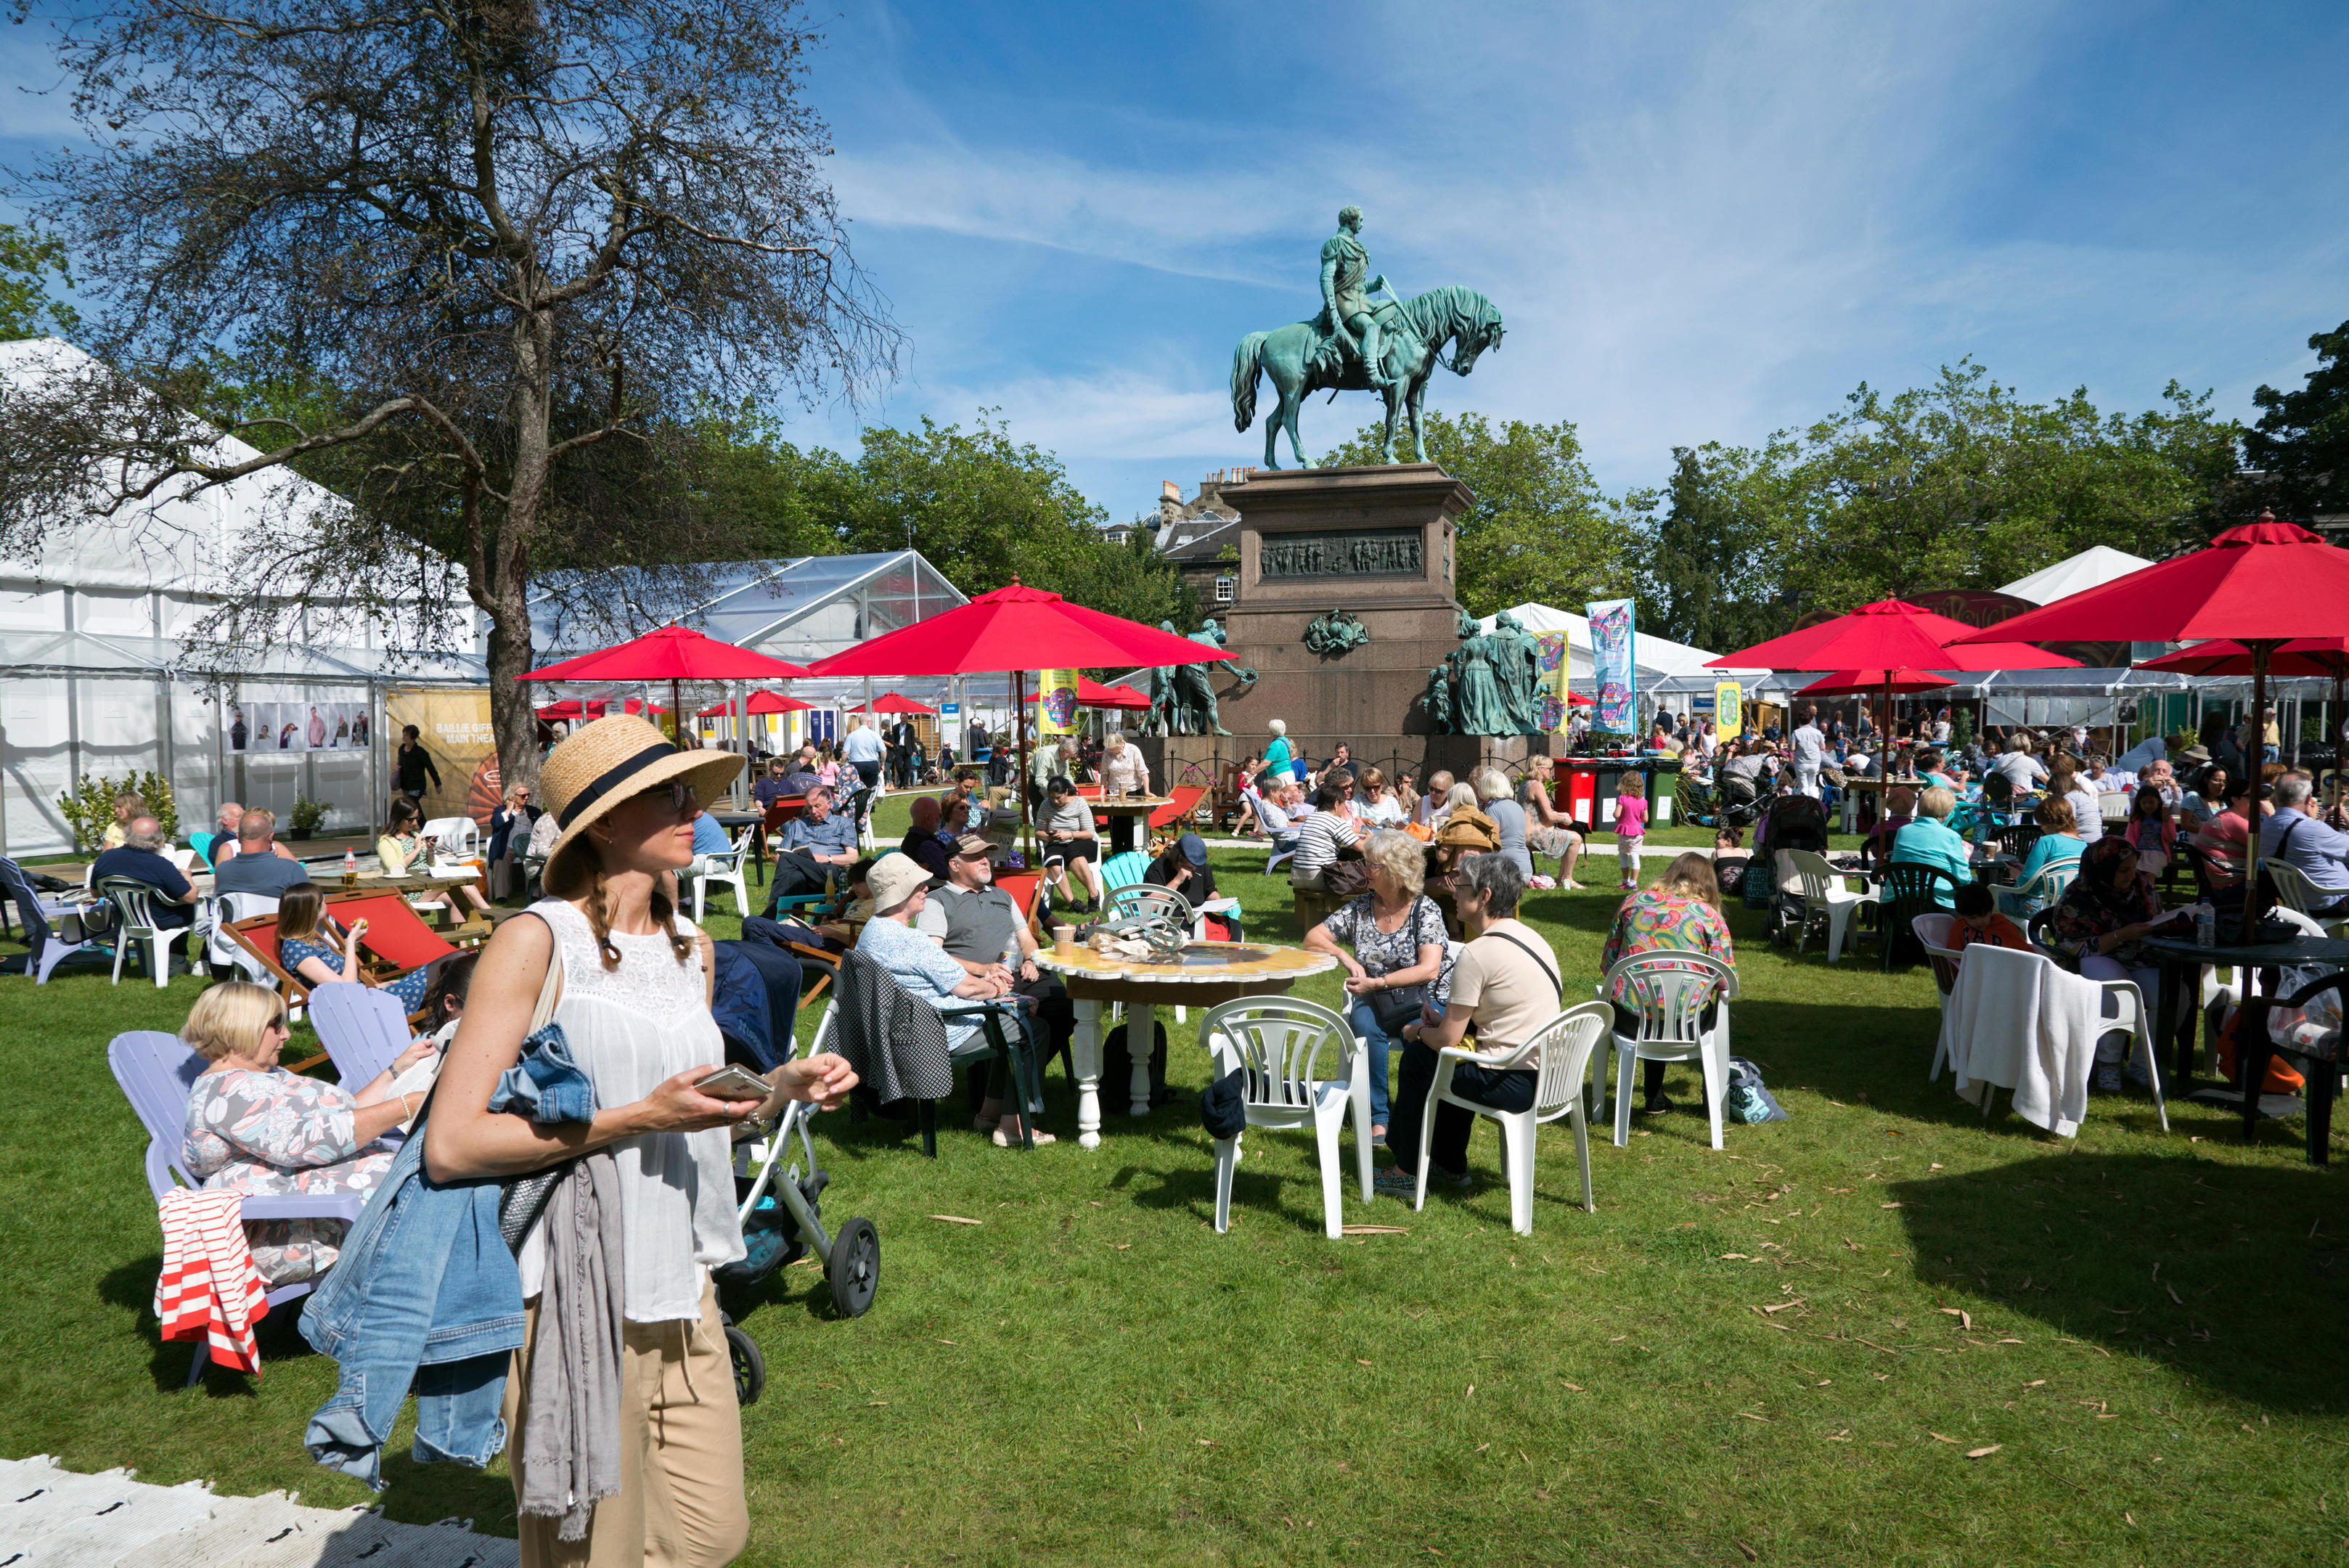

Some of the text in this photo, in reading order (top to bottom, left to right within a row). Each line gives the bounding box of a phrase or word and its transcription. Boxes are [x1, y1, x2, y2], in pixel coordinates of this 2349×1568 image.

[436, 723, 494, 733] BAILLIE GIFF
[446, 734, 469, 744] MAIN
